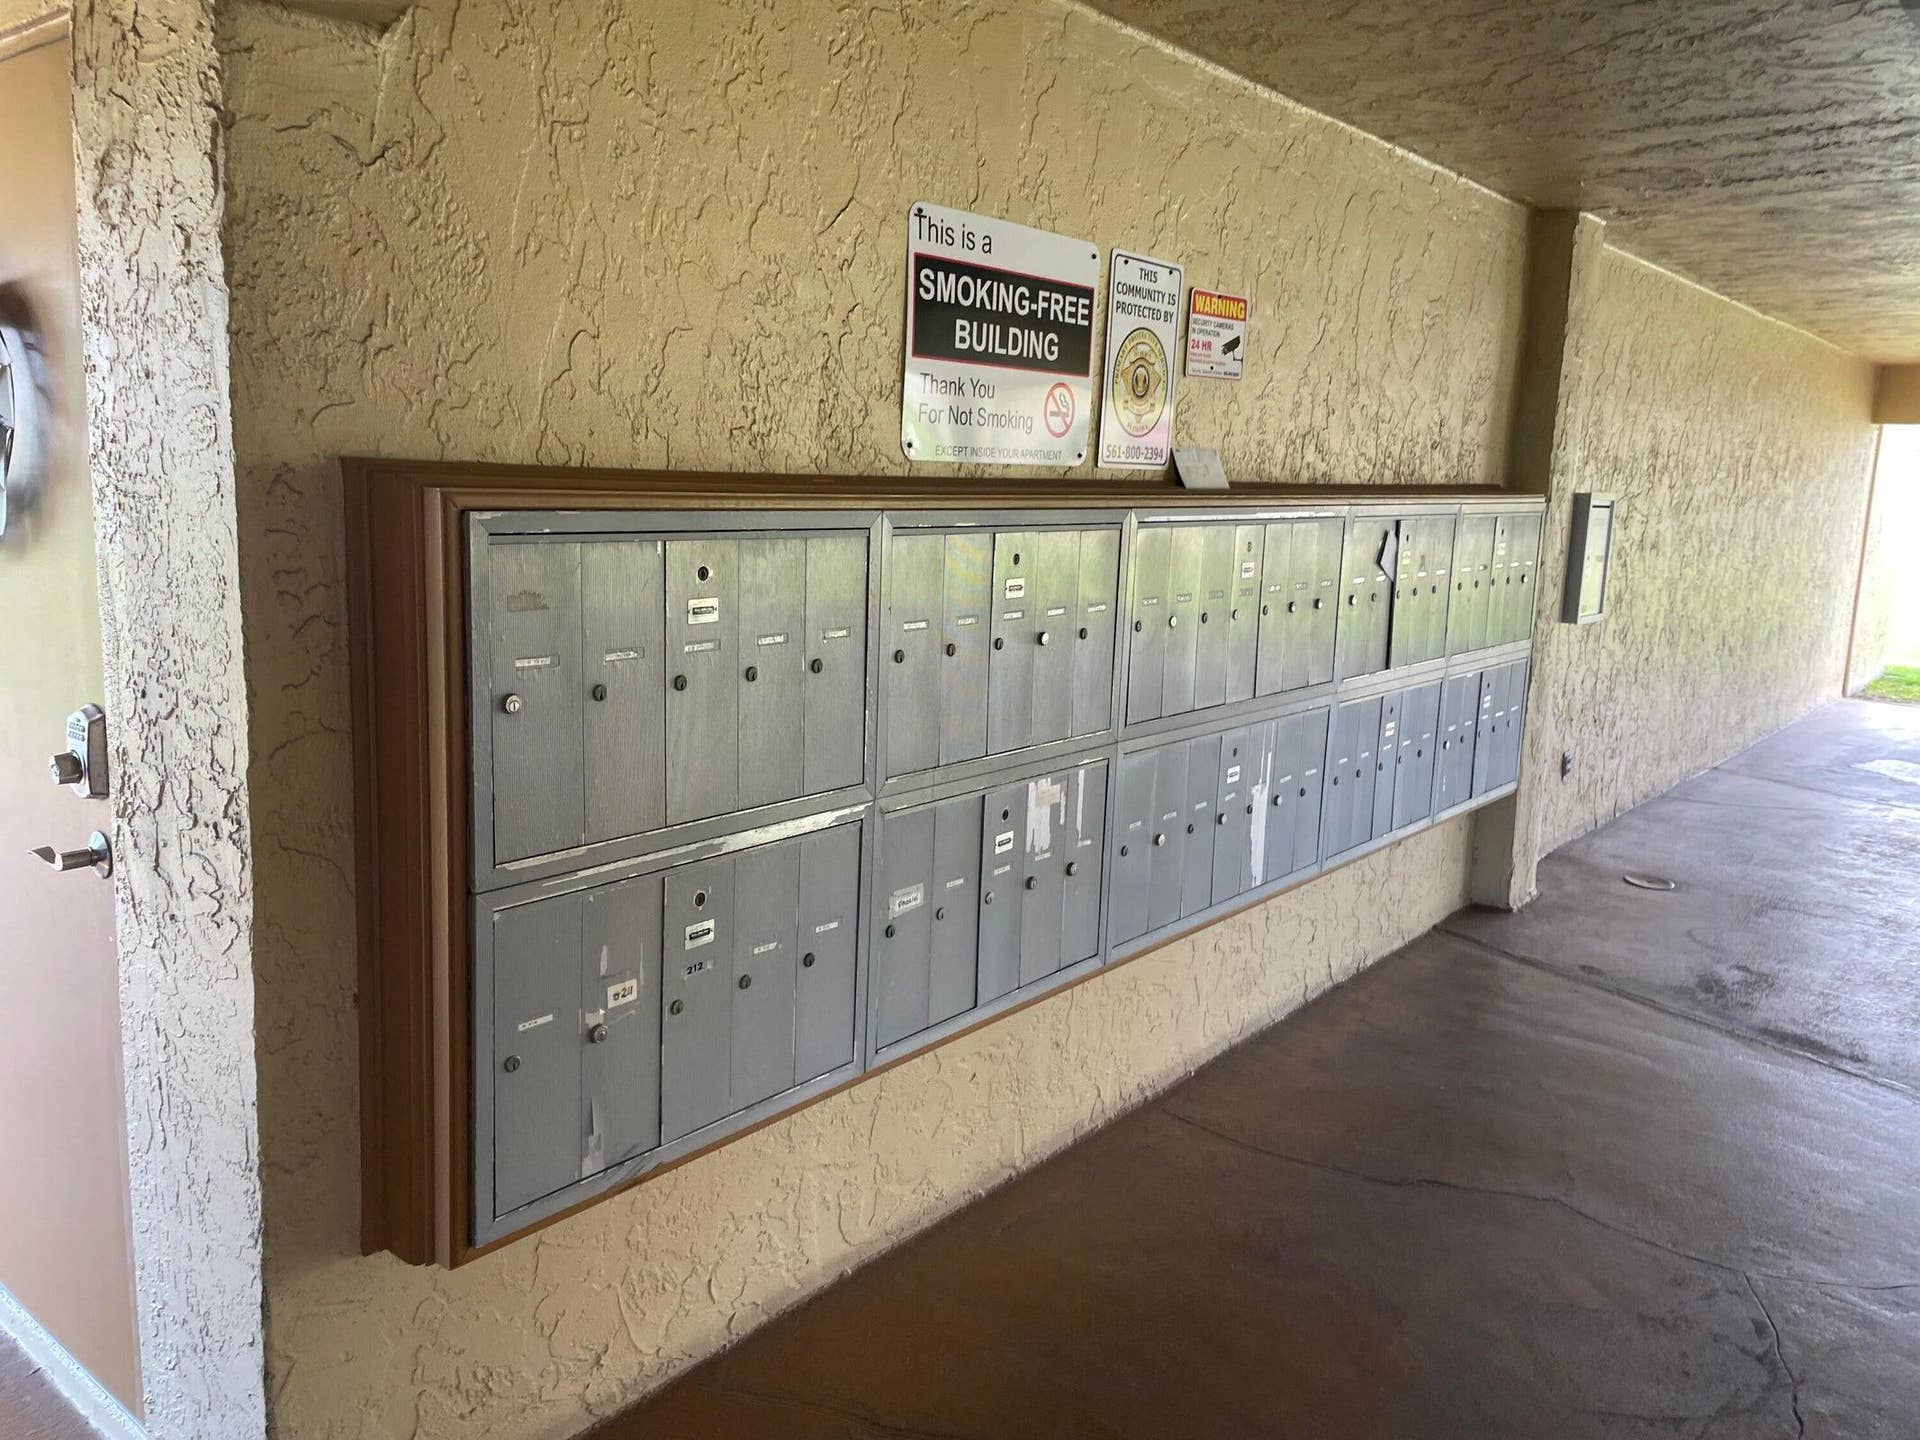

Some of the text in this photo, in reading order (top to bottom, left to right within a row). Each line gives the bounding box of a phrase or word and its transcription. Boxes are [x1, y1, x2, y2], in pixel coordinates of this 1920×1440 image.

[914, 213, 993, 255] This is a
[1139, 267, 1158, 284] THIS
[918, 268, 1090, 327] SMOKING-FREE
[1116, 281, 1177, 306] COMMUNITY IS
[1115, 301, 1174, 324] PROTECTED BY
[1195, 294, 1245, 319] WARNING
[1213, 321, 1234, 331] CAMERAS
[955, 318, 1059, 362] BUILDING
[1190, 339, 1212, 352] 24 HR
[920, 372, 995, 399] Thank You
[918, 404, 1033, 434] For Not Smoking
[935, 445, 1062, 461] EXCEPT INSIDE YOUR APARTMENT
[1106, 444, 1163, 461] 561-800-2394
[686, 962, 704, 975] 212
